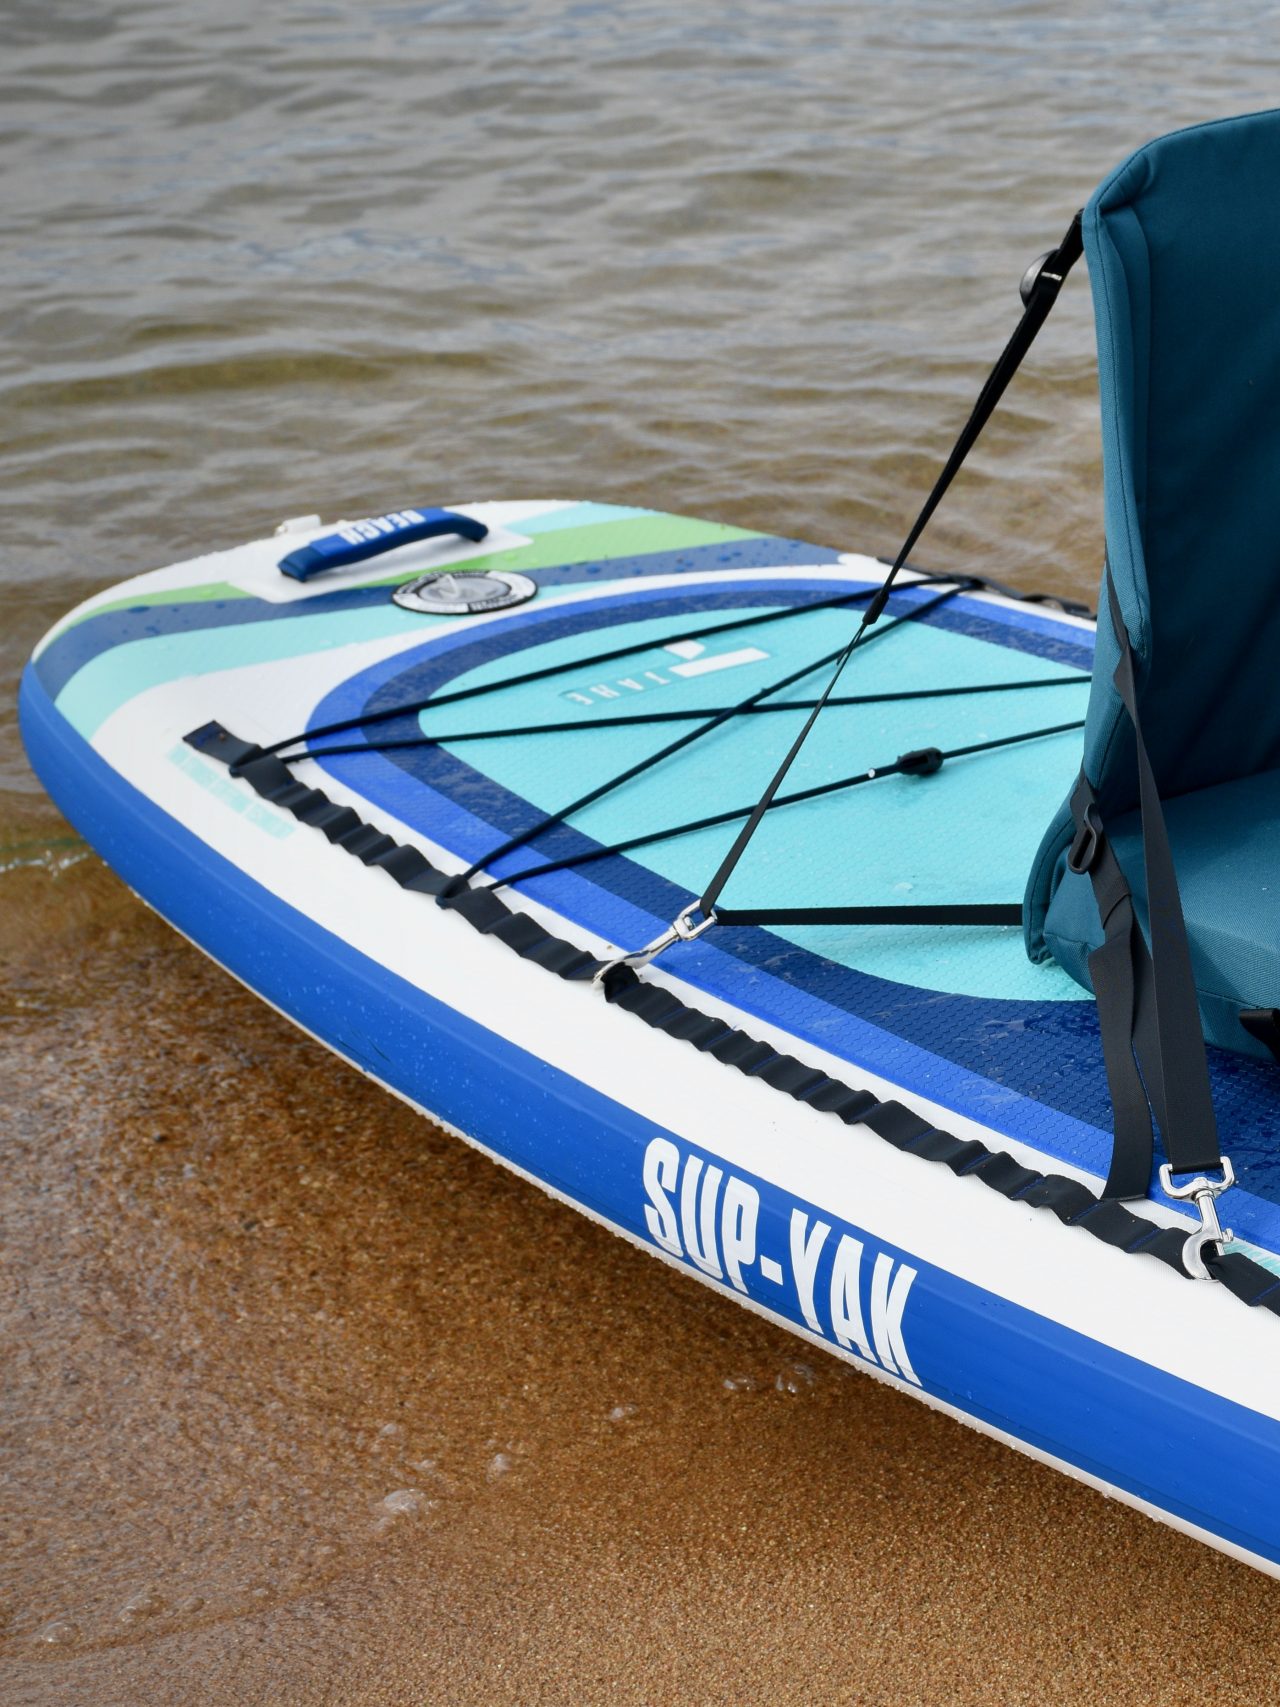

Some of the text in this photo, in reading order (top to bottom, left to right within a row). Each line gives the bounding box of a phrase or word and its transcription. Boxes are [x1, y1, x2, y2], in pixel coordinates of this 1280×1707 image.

[338, 509, 426, 545] BEACH
[566, 671, 671, 706] TAHE
[643, 1137, 923, 1387] SUP-YAK
